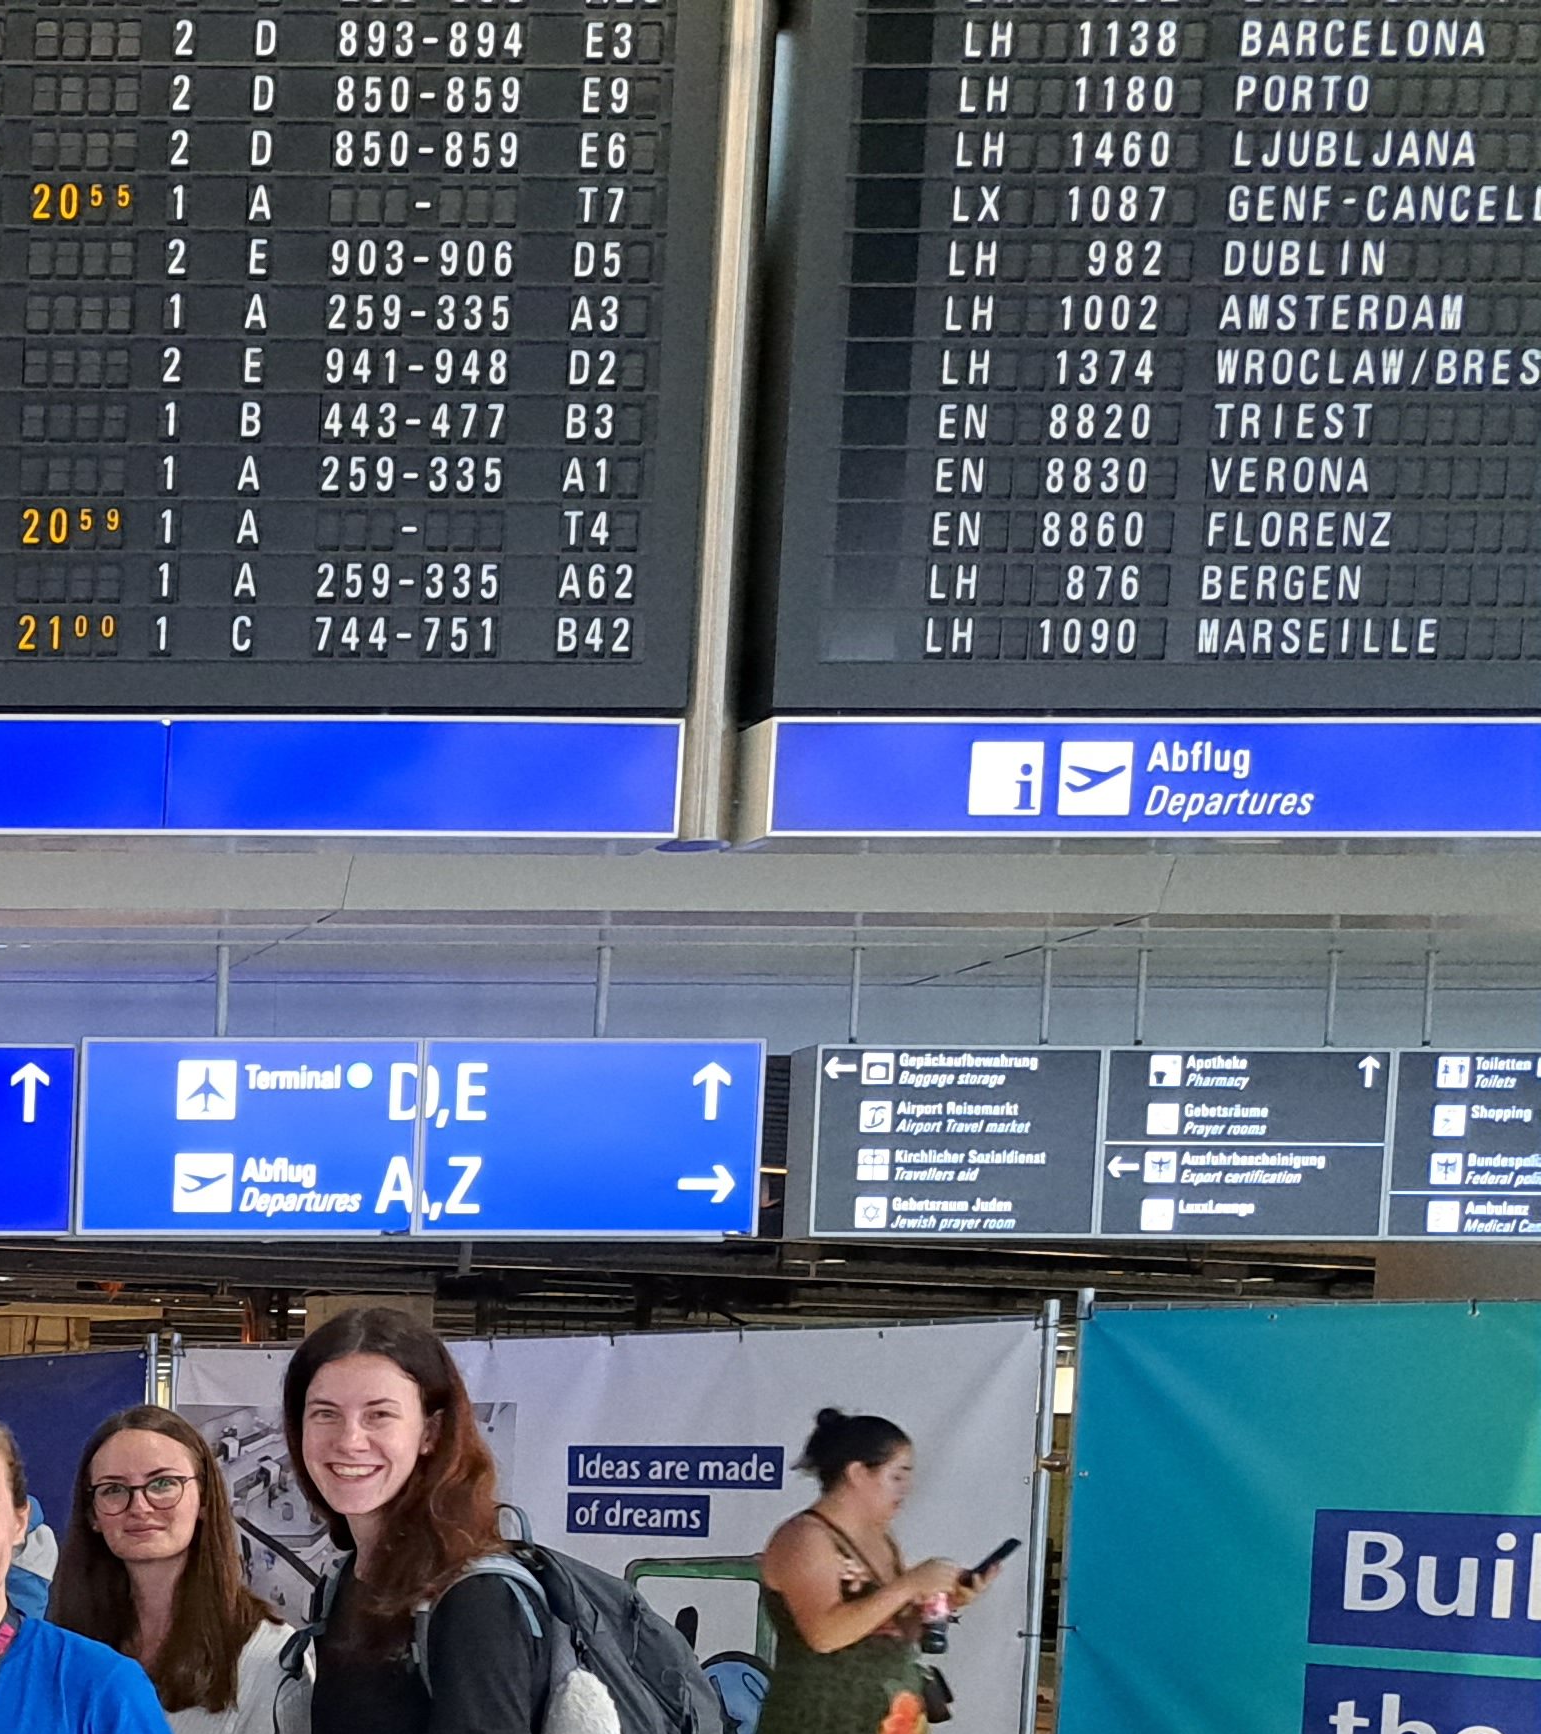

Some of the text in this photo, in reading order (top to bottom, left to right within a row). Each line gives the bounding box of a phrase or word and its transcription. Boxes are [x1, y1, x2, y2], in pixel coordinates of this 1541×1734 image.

[965, 20, 1484, 57] LH 1138 BARCELONA
[960, 75, 1368, 112] LH 1180 PORTO
[957, 130, 1475, 167] LH 1460 LJUBLJANA
[953, 186, 1000, 221] LX
[1069, 186, 1165, 221] 1087
[949, 240, 1384, 276] LH 982 DUBLIN
[946, 295, 1462, 331] LH 1002 AMSTERDAM
[943, 350, 989, 384] LH
[1057, 350, 1153, 384] 1374
[939, 403, 1372, 439] EN 8820 TRIEST
[936, 457, 1368, 493] EN 8830 VERONA
[933, 512, 1391, 546] EN 8860 FLORENZ
[931, 565, 1360, 600] LH 876 BERGEN
[927, 618, 1436, 653] LH 1090 MARSEILLE
[1147, 742, 1250, 778] Abflug
[1145, 785, 1314, 822] Departures
[245, 1064, 341, 1089] Terminal
[1186, 1055, 1247, 1072] Apotheke
[1475, 1057, 1532, 1071] Toiletten
[1186, 1074, 1250, 1090] Pharmacy
[1474, 1075, 1517, 1089] Toilets
[897, 1102, 943, 1118] Airport
[1470, 1105, 1533, 1123] Shopping
[896, 1119, 1031, 1135] Airport Travel market
[1183, 1121, 1267, 1137] Prayer rooms
[241, 1157, 316, 1188] Abflug
[1180, 1170, 1222, 1186] Export
[1465, 1172, 1513, 1185] Federal
[239, 1185, 362, 1217] Departures
[891, 1216, 1016, 1231] Jewish prayer room
[1464, 1219, 1516, 1233] Medical
[579, 1453, 774, 1481] Ideas are made
[576, 1500, 700, 1528] of dreams
